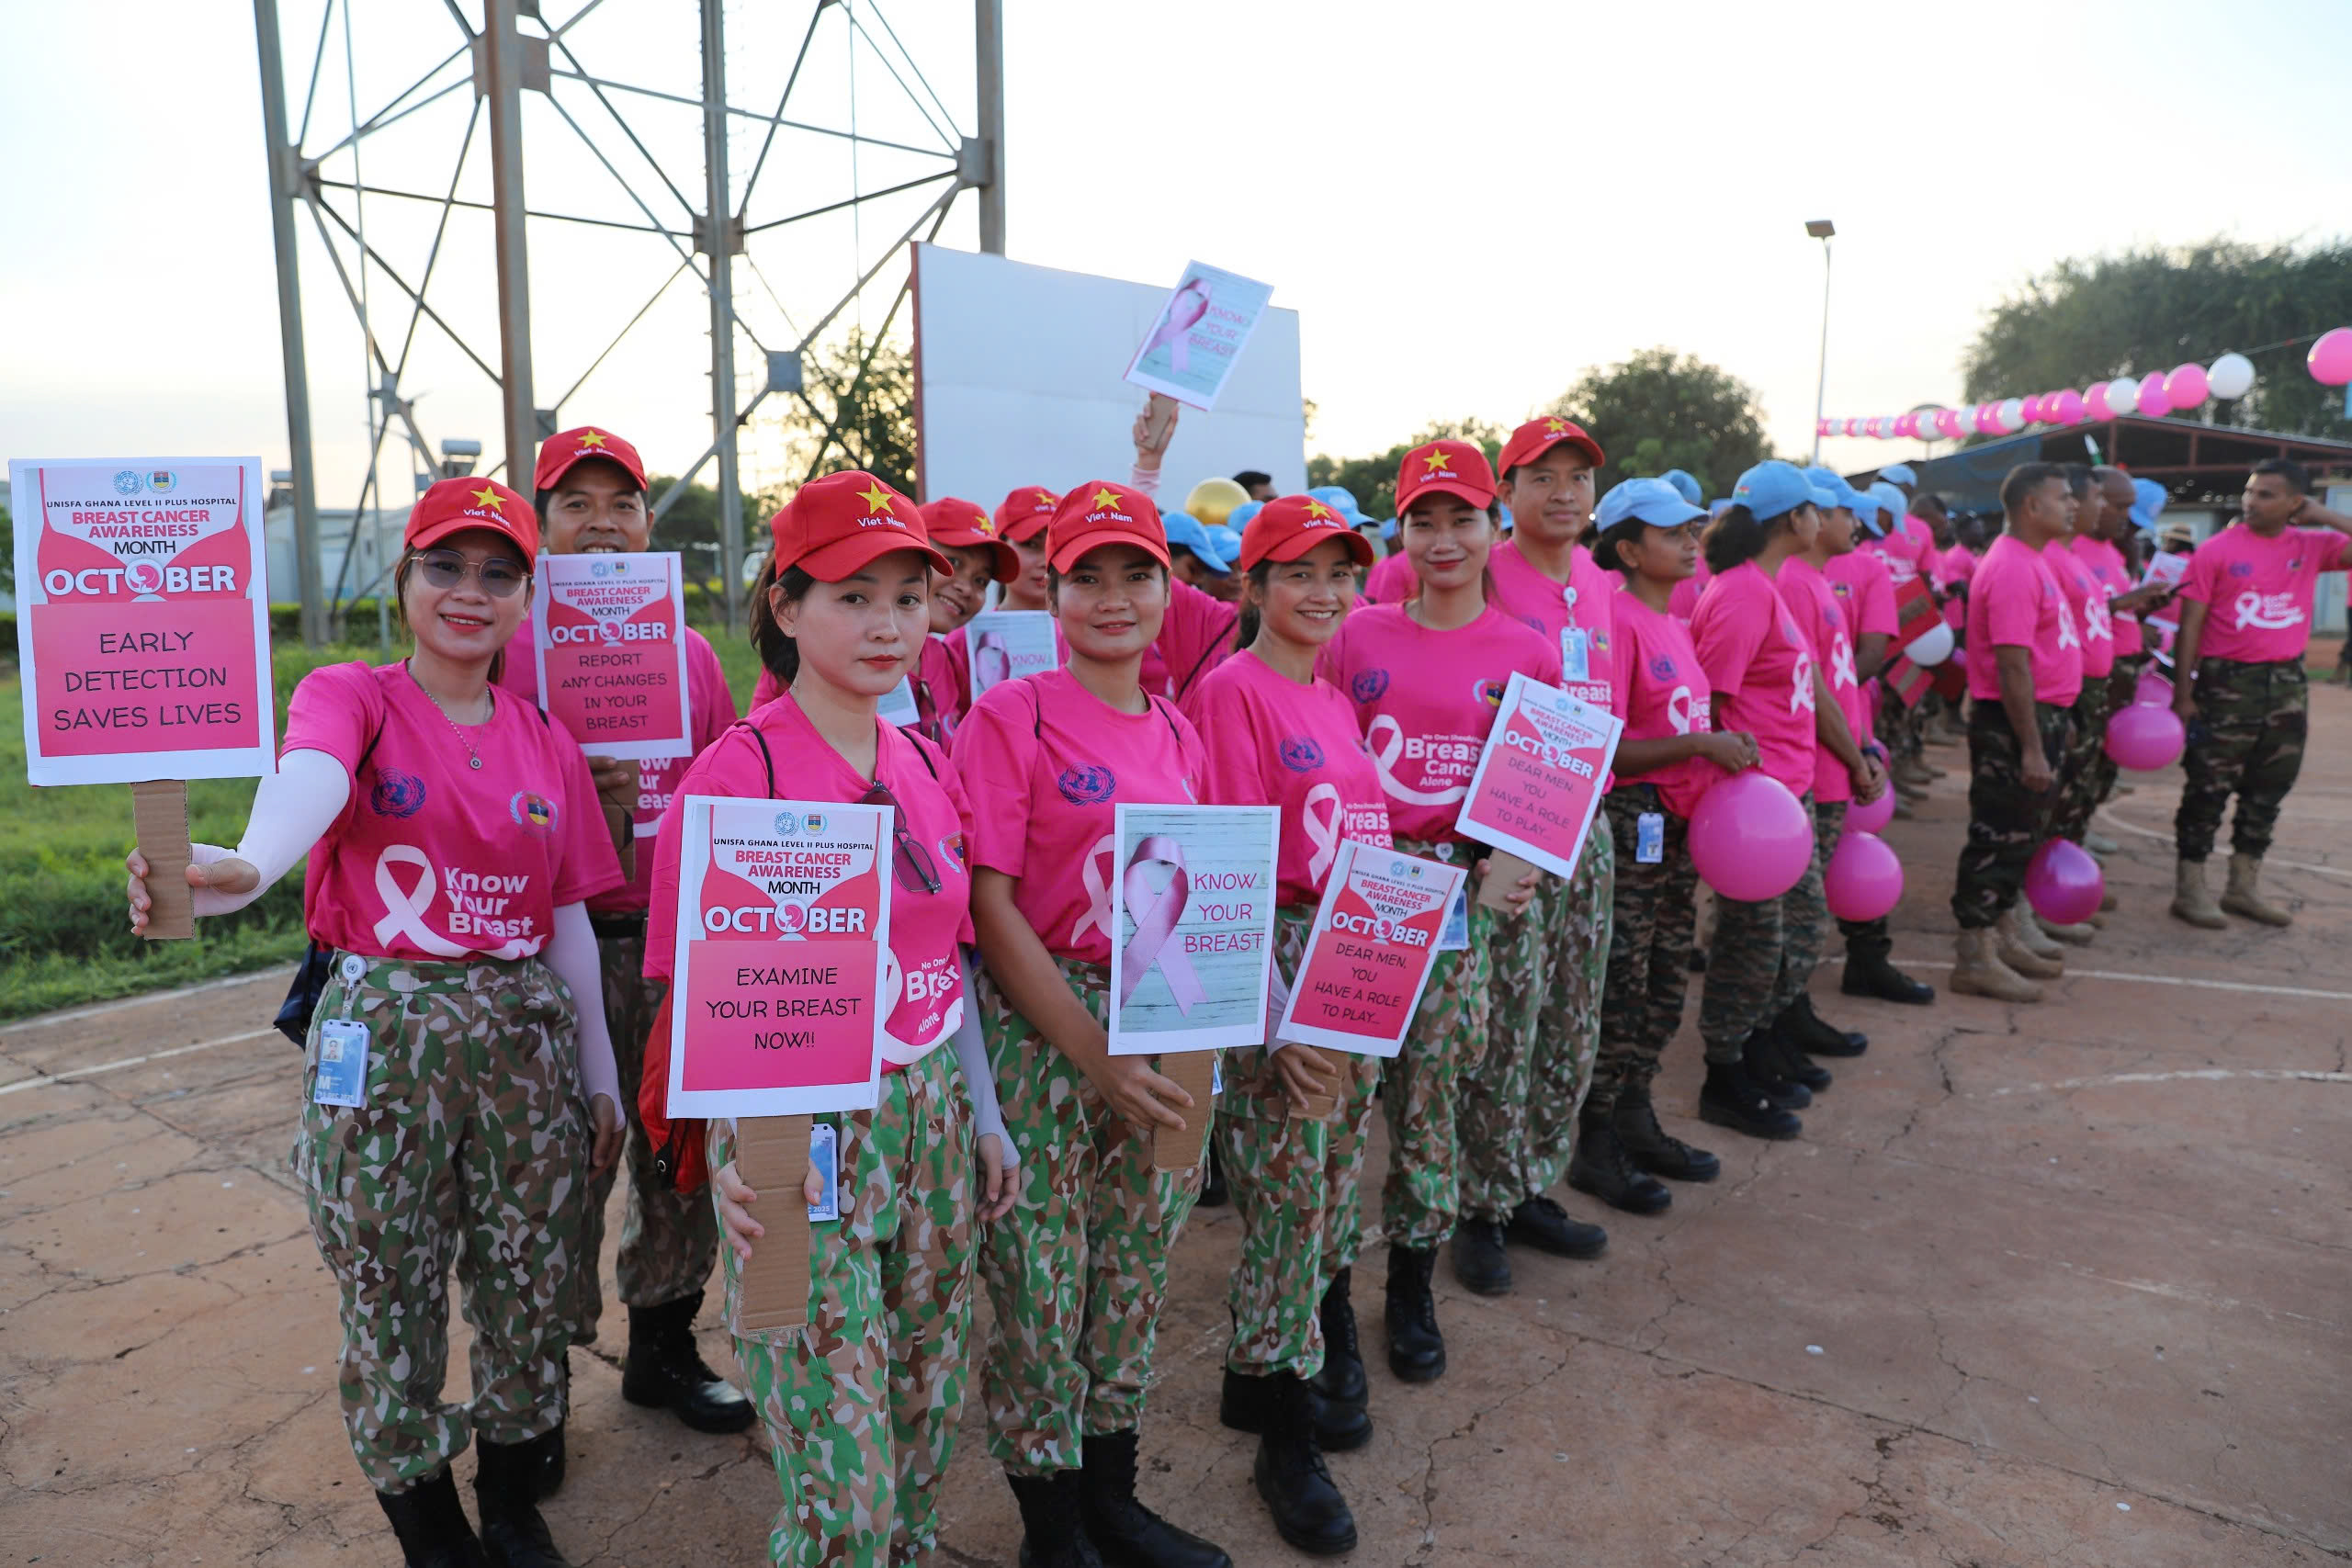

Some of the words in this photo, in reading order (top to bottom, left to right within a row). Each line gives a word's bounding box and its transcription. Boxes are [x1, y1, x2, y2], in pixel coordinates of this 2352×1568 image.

[85, 500, 119, 508] GHANA
[191, 498, 237, 506] HOSPITAL
[72, 511, 140, 525] BREAST
[141, 510, 210, 524] CANCER
[463, 508, 486, 517] Viet
[492, 512, 510, 526] Nam
[857, 517, 882, 527] Viet
[886, 516, 906, 529] Nam
[1086, 513, 1105, 523] Viet
[1110, 513, 1133, 523] Nam
[1303, 519, 1321, 528] Viet
[88, 524, 199, 538] AWARENESS
[114, 540, 175, 555] MONTH
[45, 558, 236, 595] OCTOBER
[567, 588, 606, 597] BREAST
[608, 586, 650, 595] CANCER
[577, 596, 643, 605] AWARENESS
[592, 606, 629, 616] MONTH
[551, 617, 668, 643] OCTOBER
[100, 631, 194, 654] EARLY
[579, 653, 642, 667] REPORT
[65, 668, 227, 692] DETECTION
[560, 676, 591, 689] ANY
[594, 672, 667, 688] CHANGES
[584, 697, 600, 709] IN
[605, 694, 647, 708] YOUR
[54, 706, 148, 730] SAVES
[160, 703, 242, 727] LIVES
[586, 715, 648, 730] BREAST
[639, 758, 673, 771] ow
[1425, 760, 1476, 777] Canc
[1509, 757, 1542, 779] DEAR
[639, 774, 660, 790] ur
[1419, 776, 1453, 786] Alone
[1522, 781, 1547, 799] YOU
[638, 794, 672, 809] eas
[1490, 786, 1522, 808] HAVE
[1526, 803, 1533, 813] A
[1538, 807, 1570, 829] ROLE
[1498, 808, 1512, 822] TO
[714, 838, 745, 847] UNISFA
[837, 842, 874, 851] HOSPITAL
[735, 850, 794, 864] BREAST
[794, 852, 851, 865] CANCER
[748, 864, 841, 879] AWARENESS
[444, 867, 529, 894] Know
[768, 881, 820, 895] MONTH
[1194, 873, 1257, 890] KNOW
[1361, 879, 1396, 894] BREAST
[1396, 888, 1431, 902] CANCER
[445, 890, 509, 916] Your
[1366, 891, 1422, 910] AWARENESS
[704, 898, 865, 933] OCTOBER
[1198, 904, 1252, 921] YOUR
[1374, 903, 1408, 918] MONTH
[448, 912, 533, 938] Breast
[1331, 911, 1430, 947] OCTOBER
[1185, 933, 1264, 953] BREAST
[1336, 942, 1373, 961] DEAR
[922, 962, 932, 970] No
[1352, 967, 1377, 982] YOU
[737, 967, 838, 987] EXAMINE
[1315, 981, 1349, 998] HAVE
[1352, 989, 1363, 1000] A
[1366, 991, 1402, 1008] ROLE
[706, 999, 767, 1019] YOUR
[776, 998, 861, 1018] BREAST
[1323, 1003, 1339, 1017] TO
[919, 1011, 940, 1035] Alone
[754, 1032, 815, 1050] NOW!!
